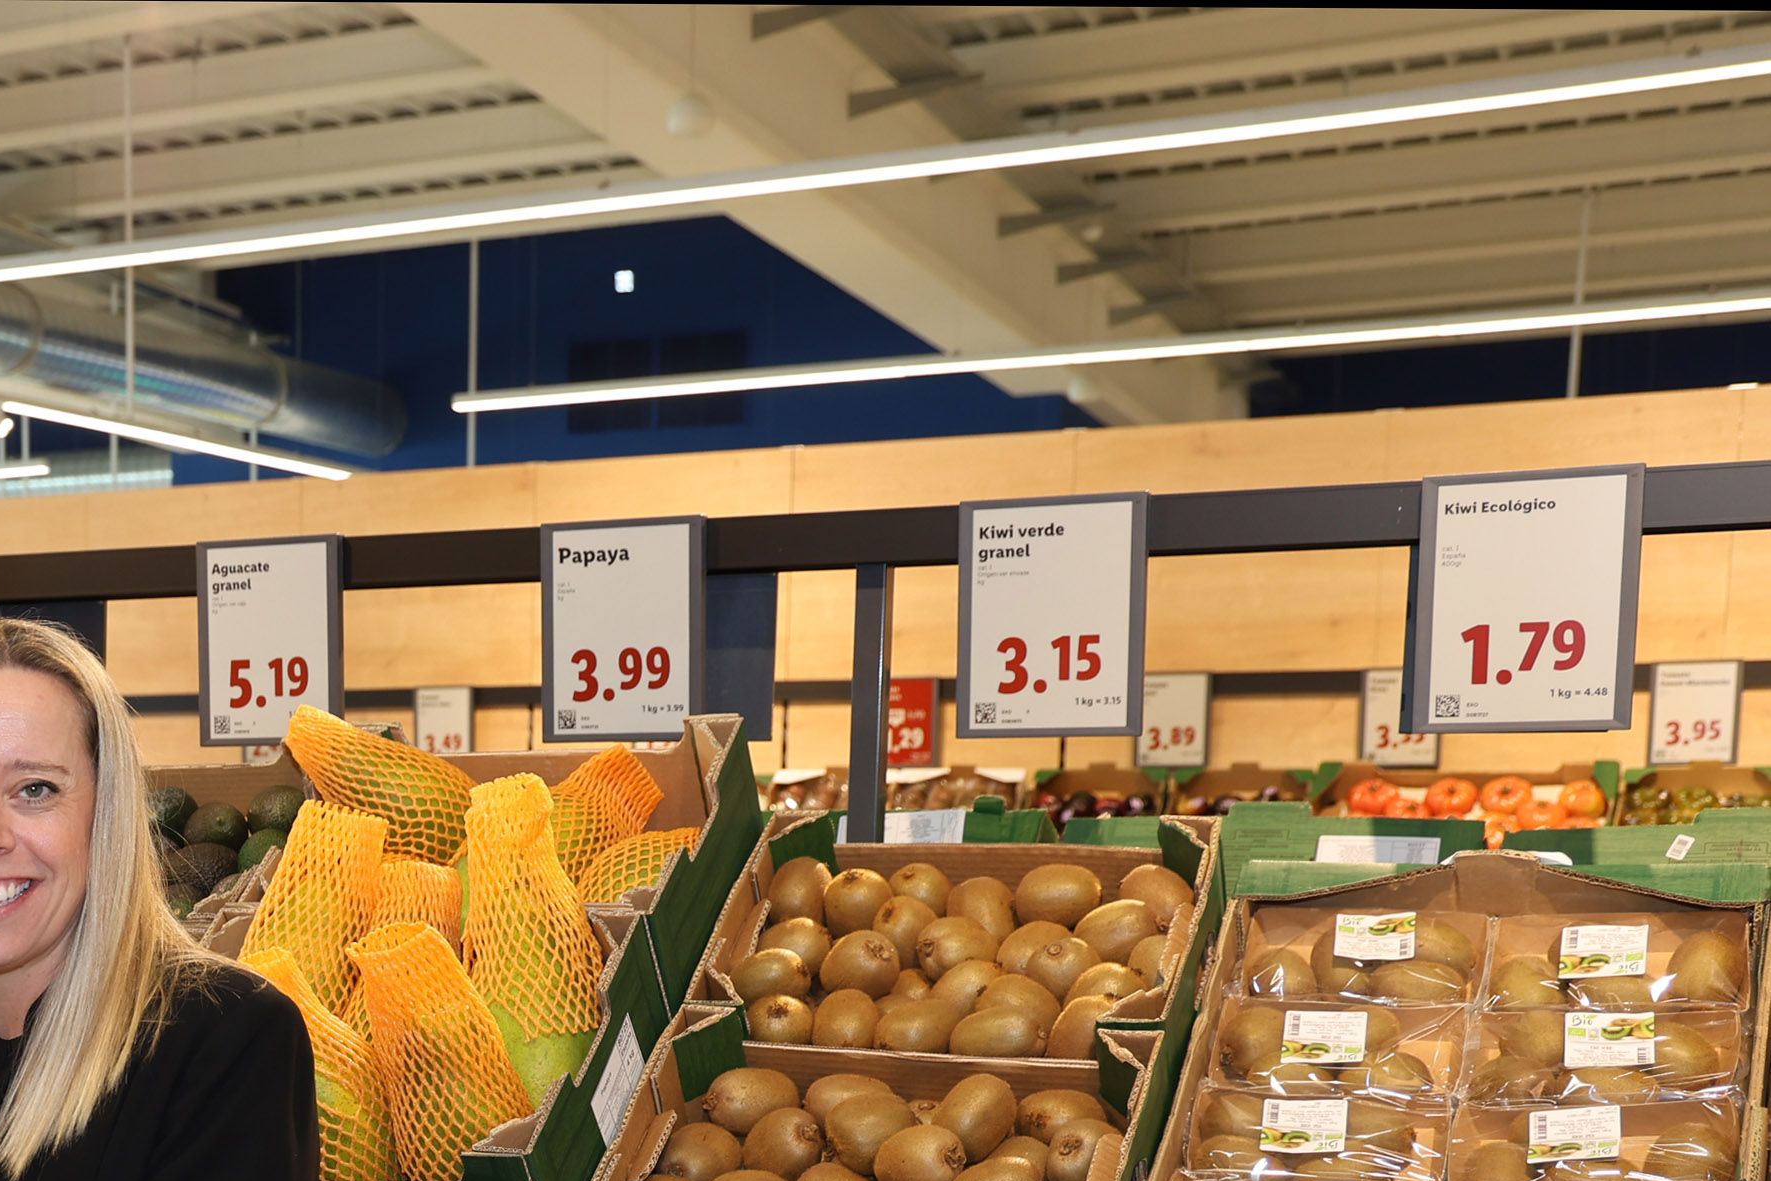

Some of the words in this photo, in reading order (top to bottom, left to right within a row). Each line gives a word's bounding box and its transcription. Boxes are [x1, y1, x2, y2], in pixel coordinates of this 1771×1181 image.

[1444, 501, 1477, 515] Kiwi
[1481, 497, 1556, 515] Ecológico
[978, 525, 1014, 540] Kiwi
[1018, 522, 1065, 538] verde
[558, 547, 630, 568] Papaya
[978, 543, 1031, 563] granel
[212, 562, 270, 577] Aguacate
[212, 578, 252, 595] granel
[1461, 619, 1586, 685] 1.79
[996, 634, 1102, 694] 3.15
[229, 656, 309, 709] 5.19
[571, 646, 671, 703] 3.99
[1075, 697, 1079, 706] 1
[1082, 697, 1093, 708] kg
[1104, 696, 1122, 705] 3.15
[1550, 689, 1555, 698] 1
[1558, 688, 1572, 699] kg
[1584, 687, 1609, 697] 4.48
[642, 705, 646, 713] 1
[647, 704, 658, 715] kg
[667, 704, 684, 713] 3.99
[1148, 726, 1197, 751] 3.89
[1665, 719, 1723, 746] 3.95
[426, 733, 463, 754] 3.49
[1571, 1015, 1594, 1027] Bio
